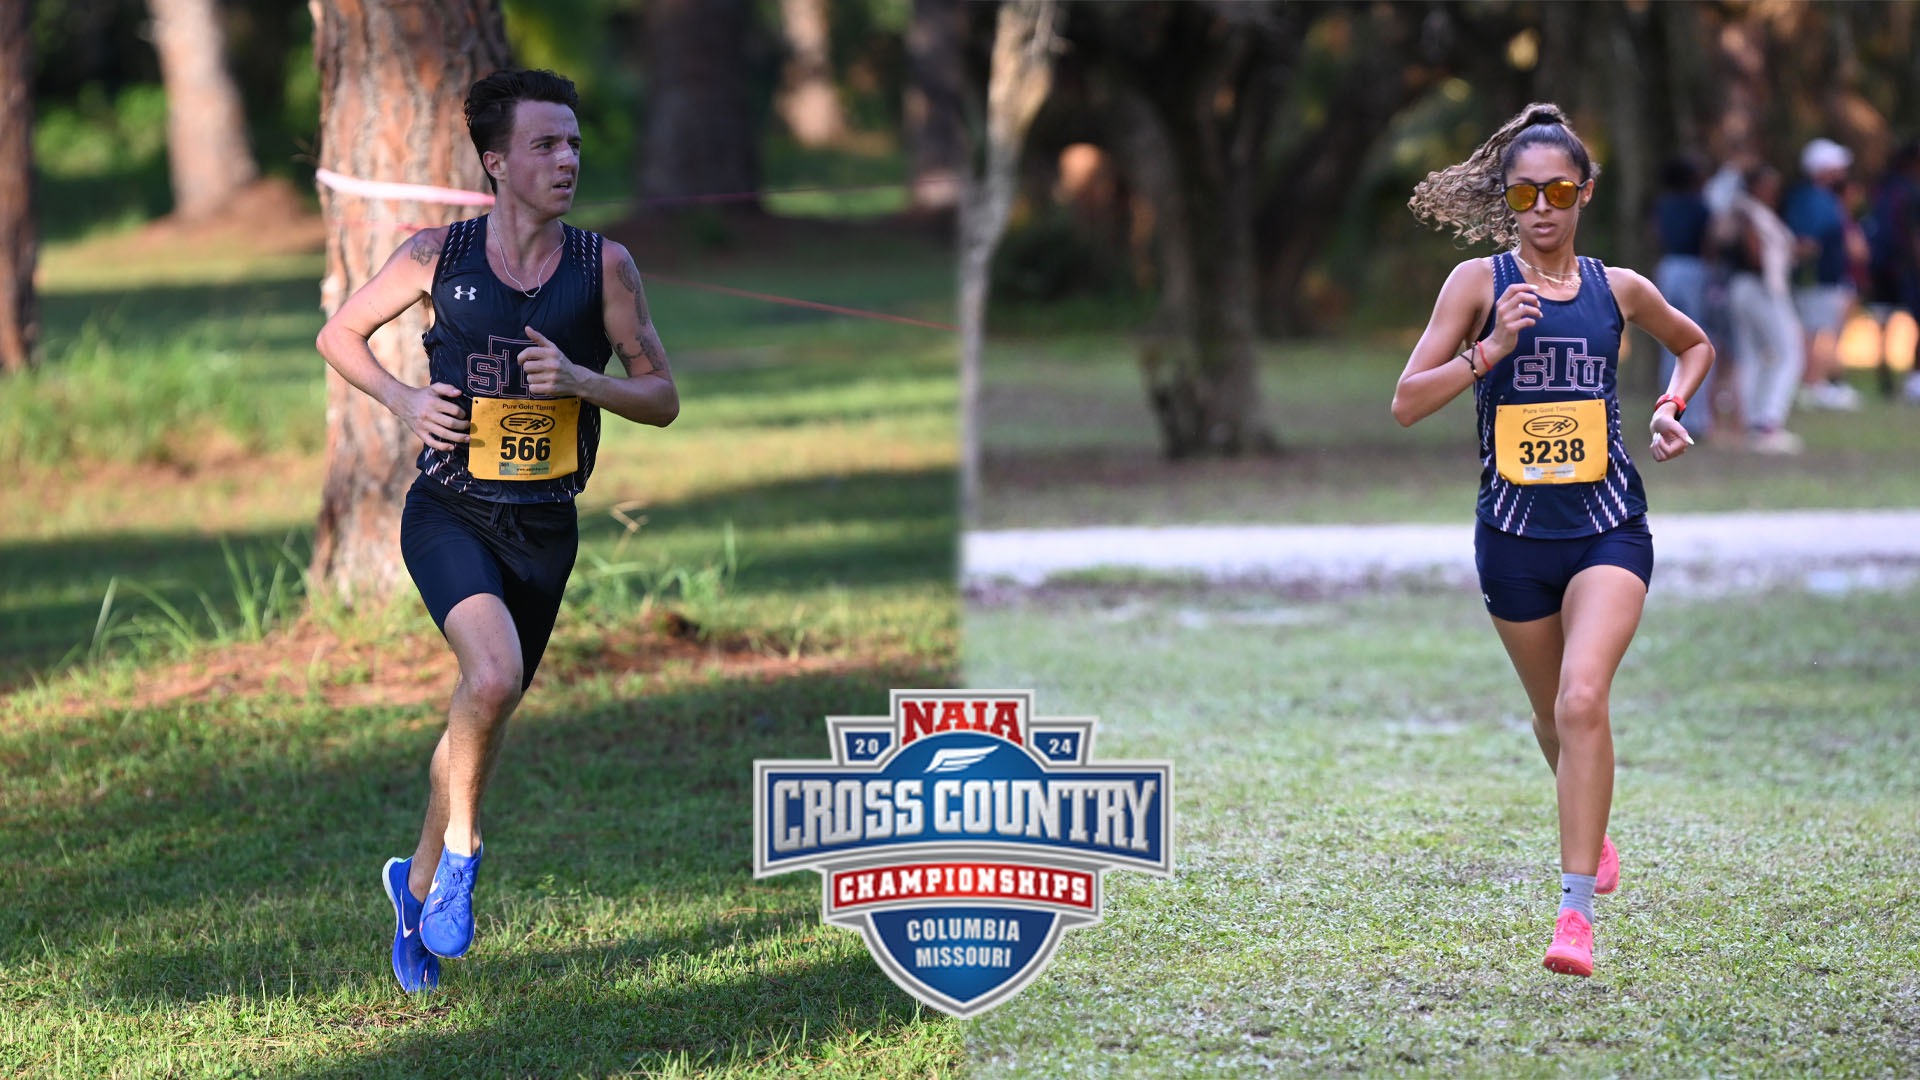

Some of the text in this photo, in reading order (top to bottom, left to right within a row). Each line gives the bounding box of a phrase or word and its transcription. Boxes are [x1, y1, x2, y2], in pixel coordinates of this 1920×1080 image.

[1513, 337, 1607, 391] STU
[500, 436, 551, 461] 566
[1519, 438, 1585, 465] 3238
